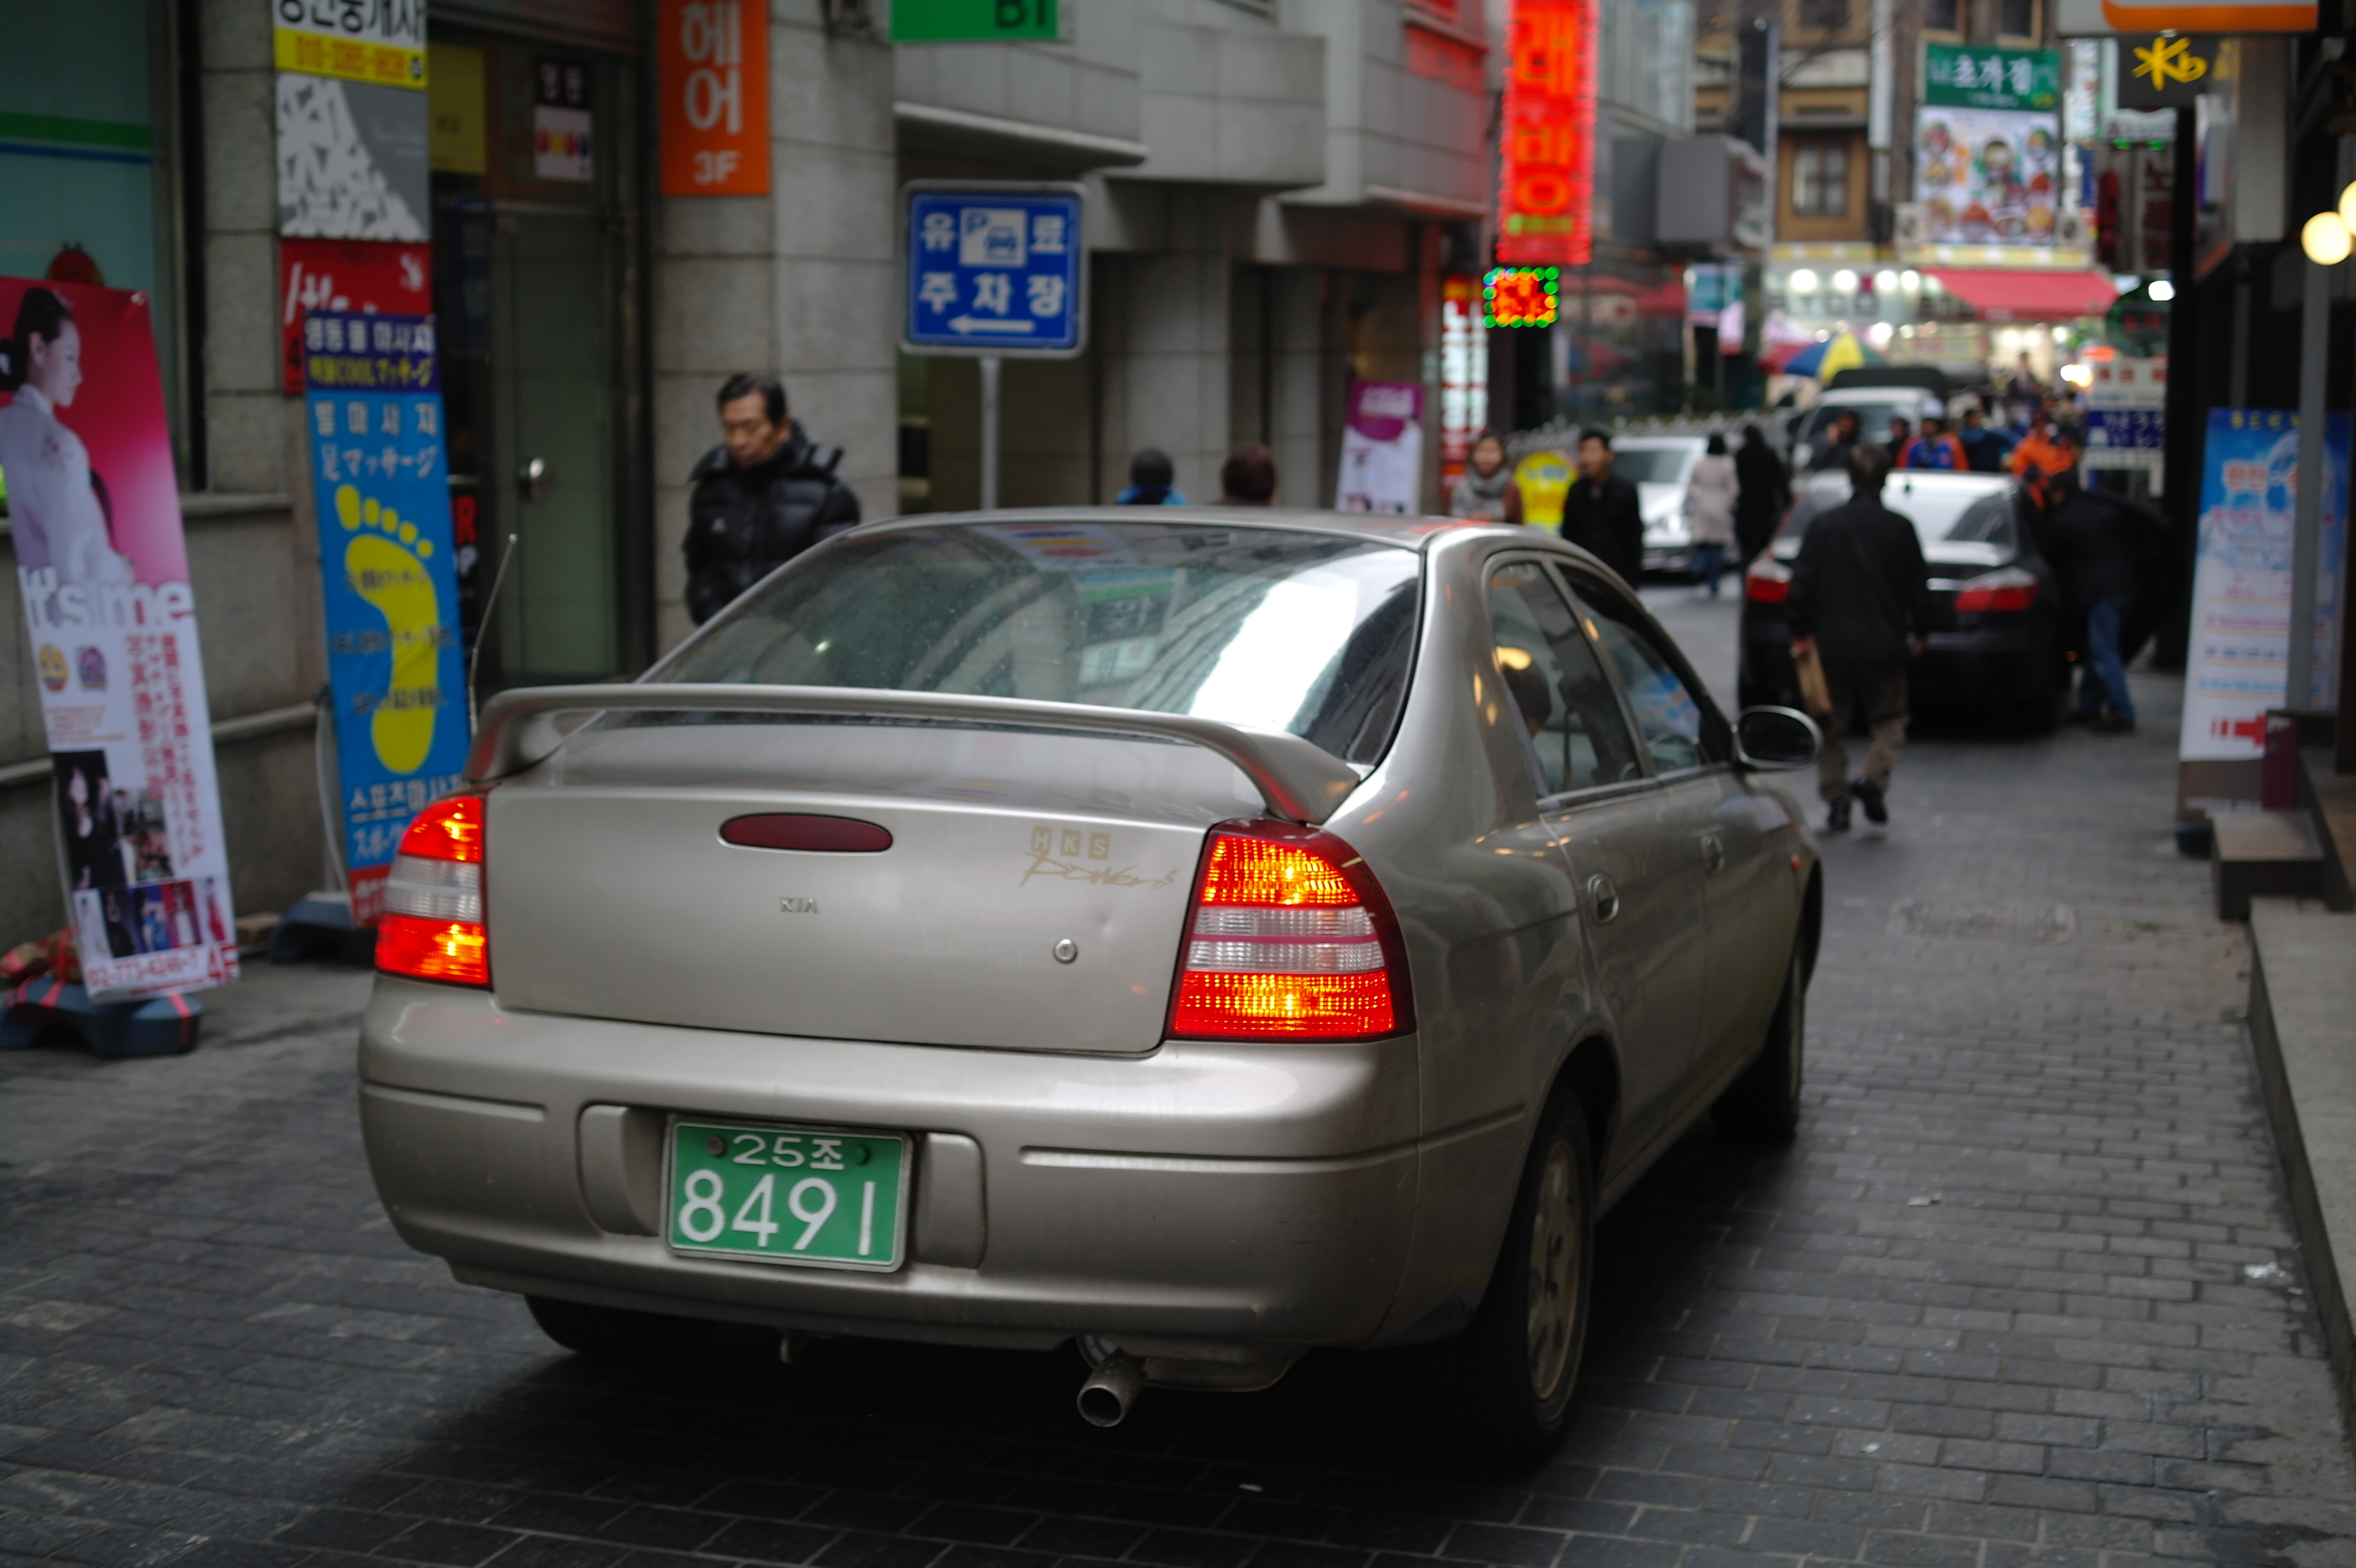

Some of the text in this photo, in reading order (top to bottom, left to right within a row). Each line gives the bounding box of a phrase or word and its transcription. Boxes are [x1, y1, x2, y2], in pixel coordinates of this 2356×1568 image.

[679, 1, 742, 134] 헤어
[693, 150, 738, 186] 3F
[918, 271, 1068, 317] 주차장
[1031, 826, 1110, 860] HKS
[779, 895, 819, 914] KIA
[732, 1134, 845, 1170] 25조
[678, 1169, 876, 1257] 8491
